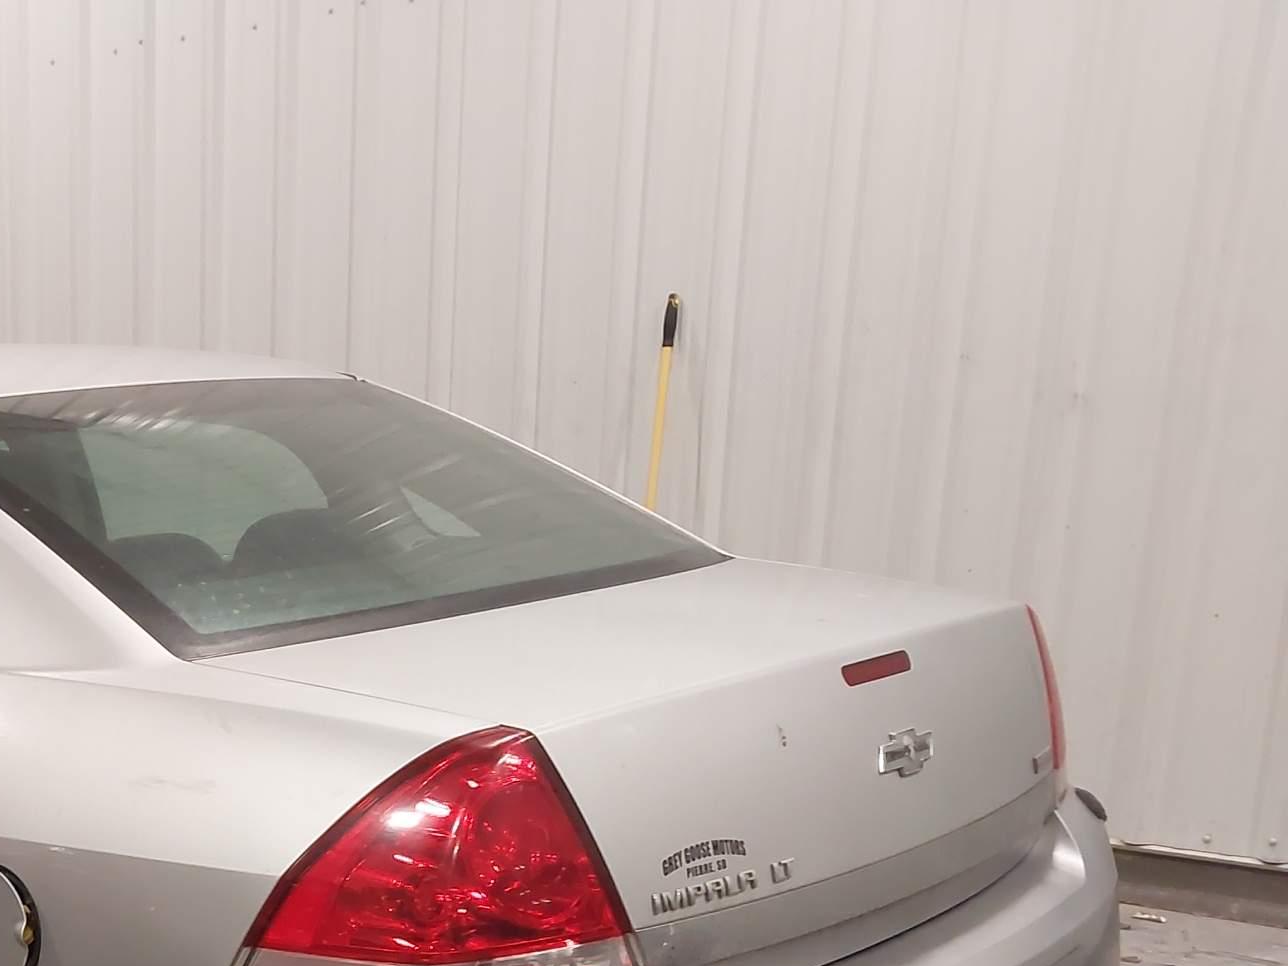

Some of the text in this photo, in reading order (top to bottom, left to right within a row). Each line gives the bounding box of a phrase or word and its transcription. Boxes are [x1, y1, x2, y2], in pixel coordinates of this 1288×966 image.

[662, 838, 747, 877] GREY GOOSE MOTORS
[650, 857, 795, 916] IMPALA LT
